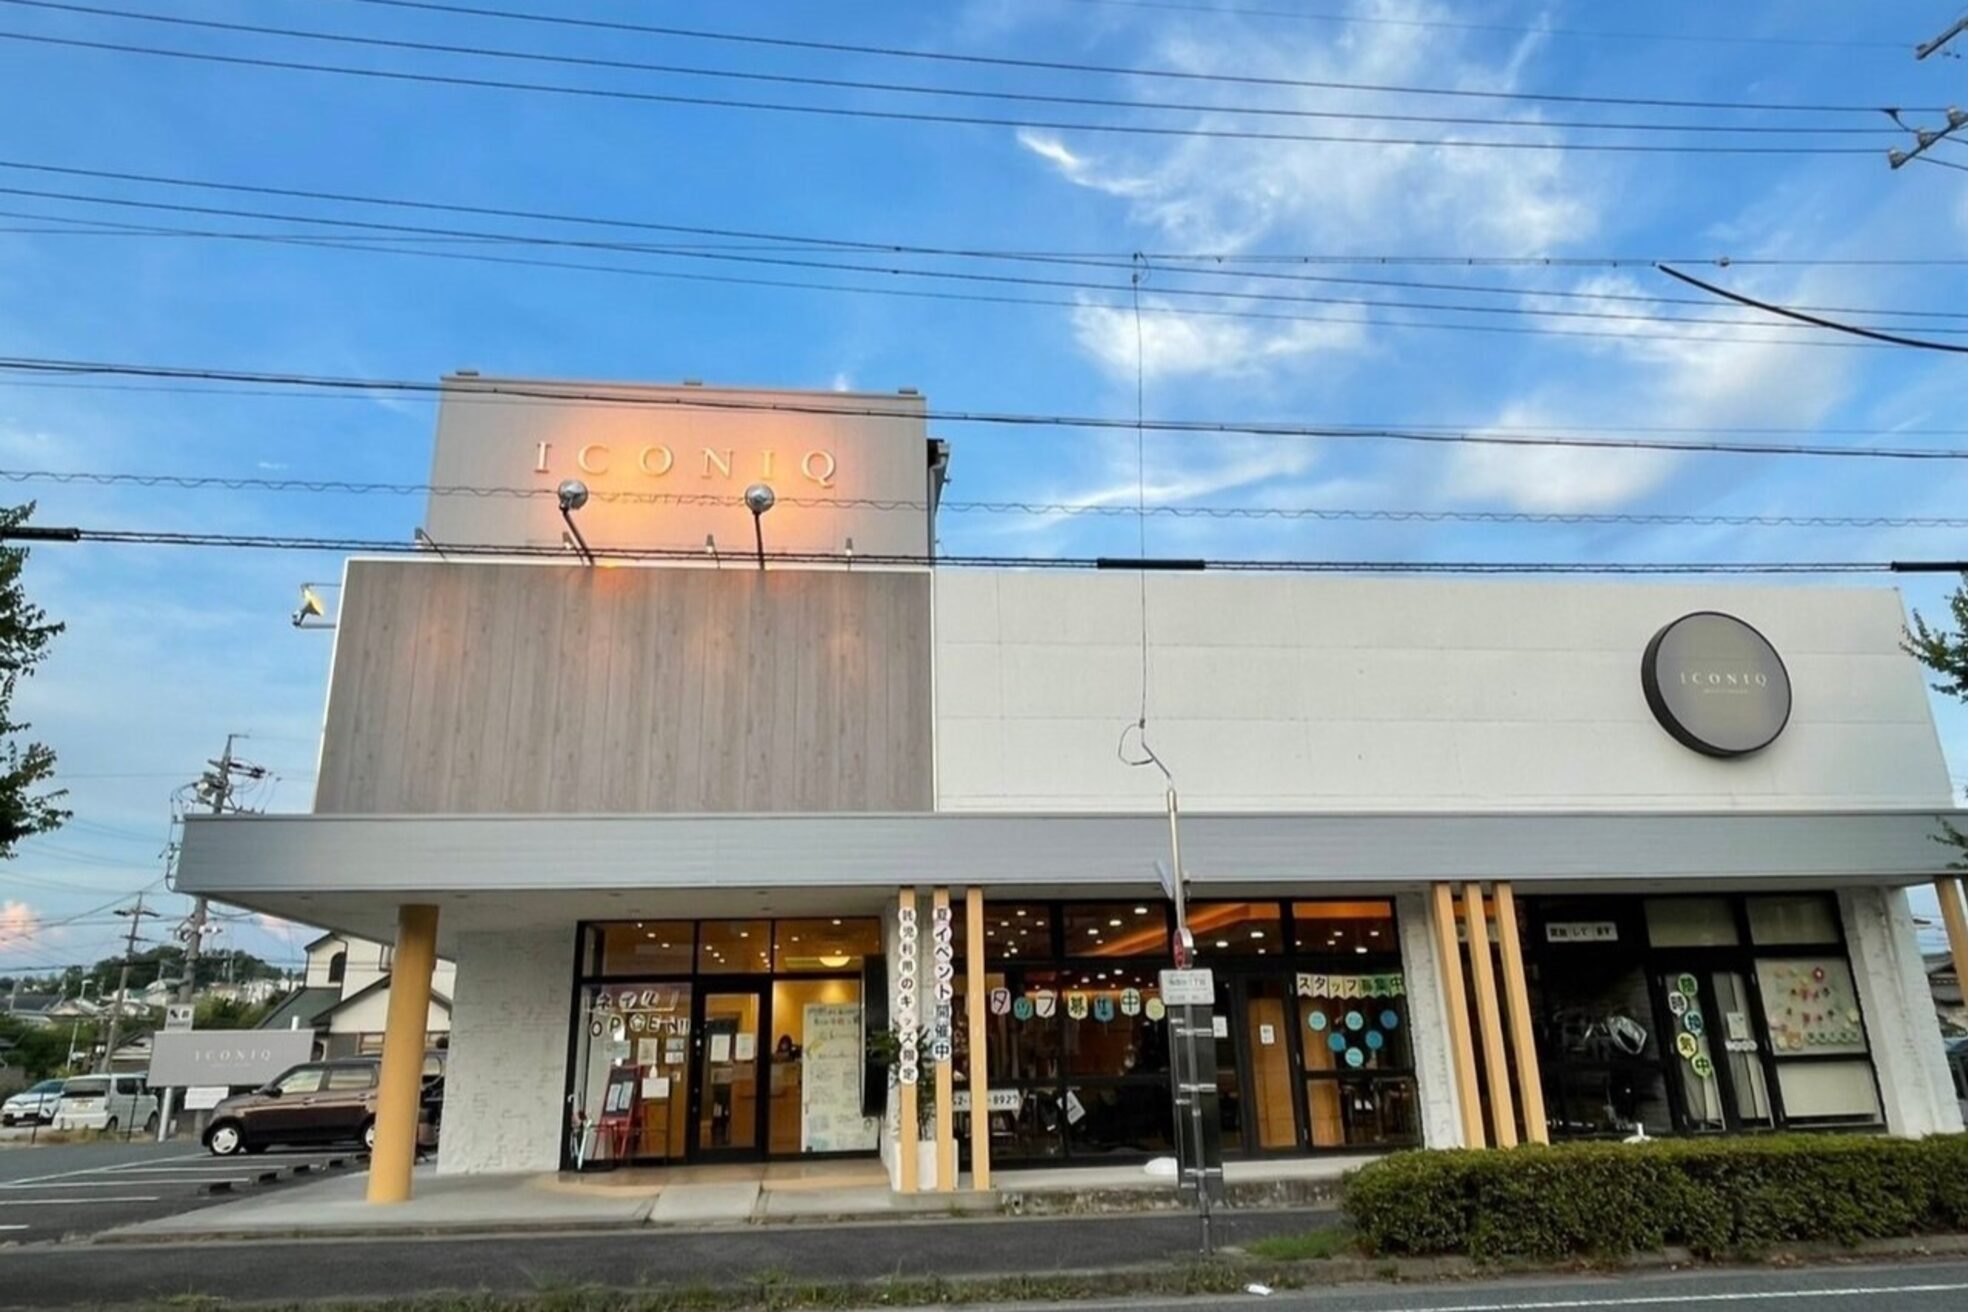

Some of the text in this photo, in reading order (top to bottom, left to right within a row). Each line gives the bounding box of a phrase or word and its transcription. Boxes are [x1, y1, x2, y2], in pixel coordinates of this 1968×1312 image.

[533, 441, 837, 488] ICONIQ
[1680, 672, 1767, 688] ICONIQ
[194, 1049, 271, 1061] ICONIQ
